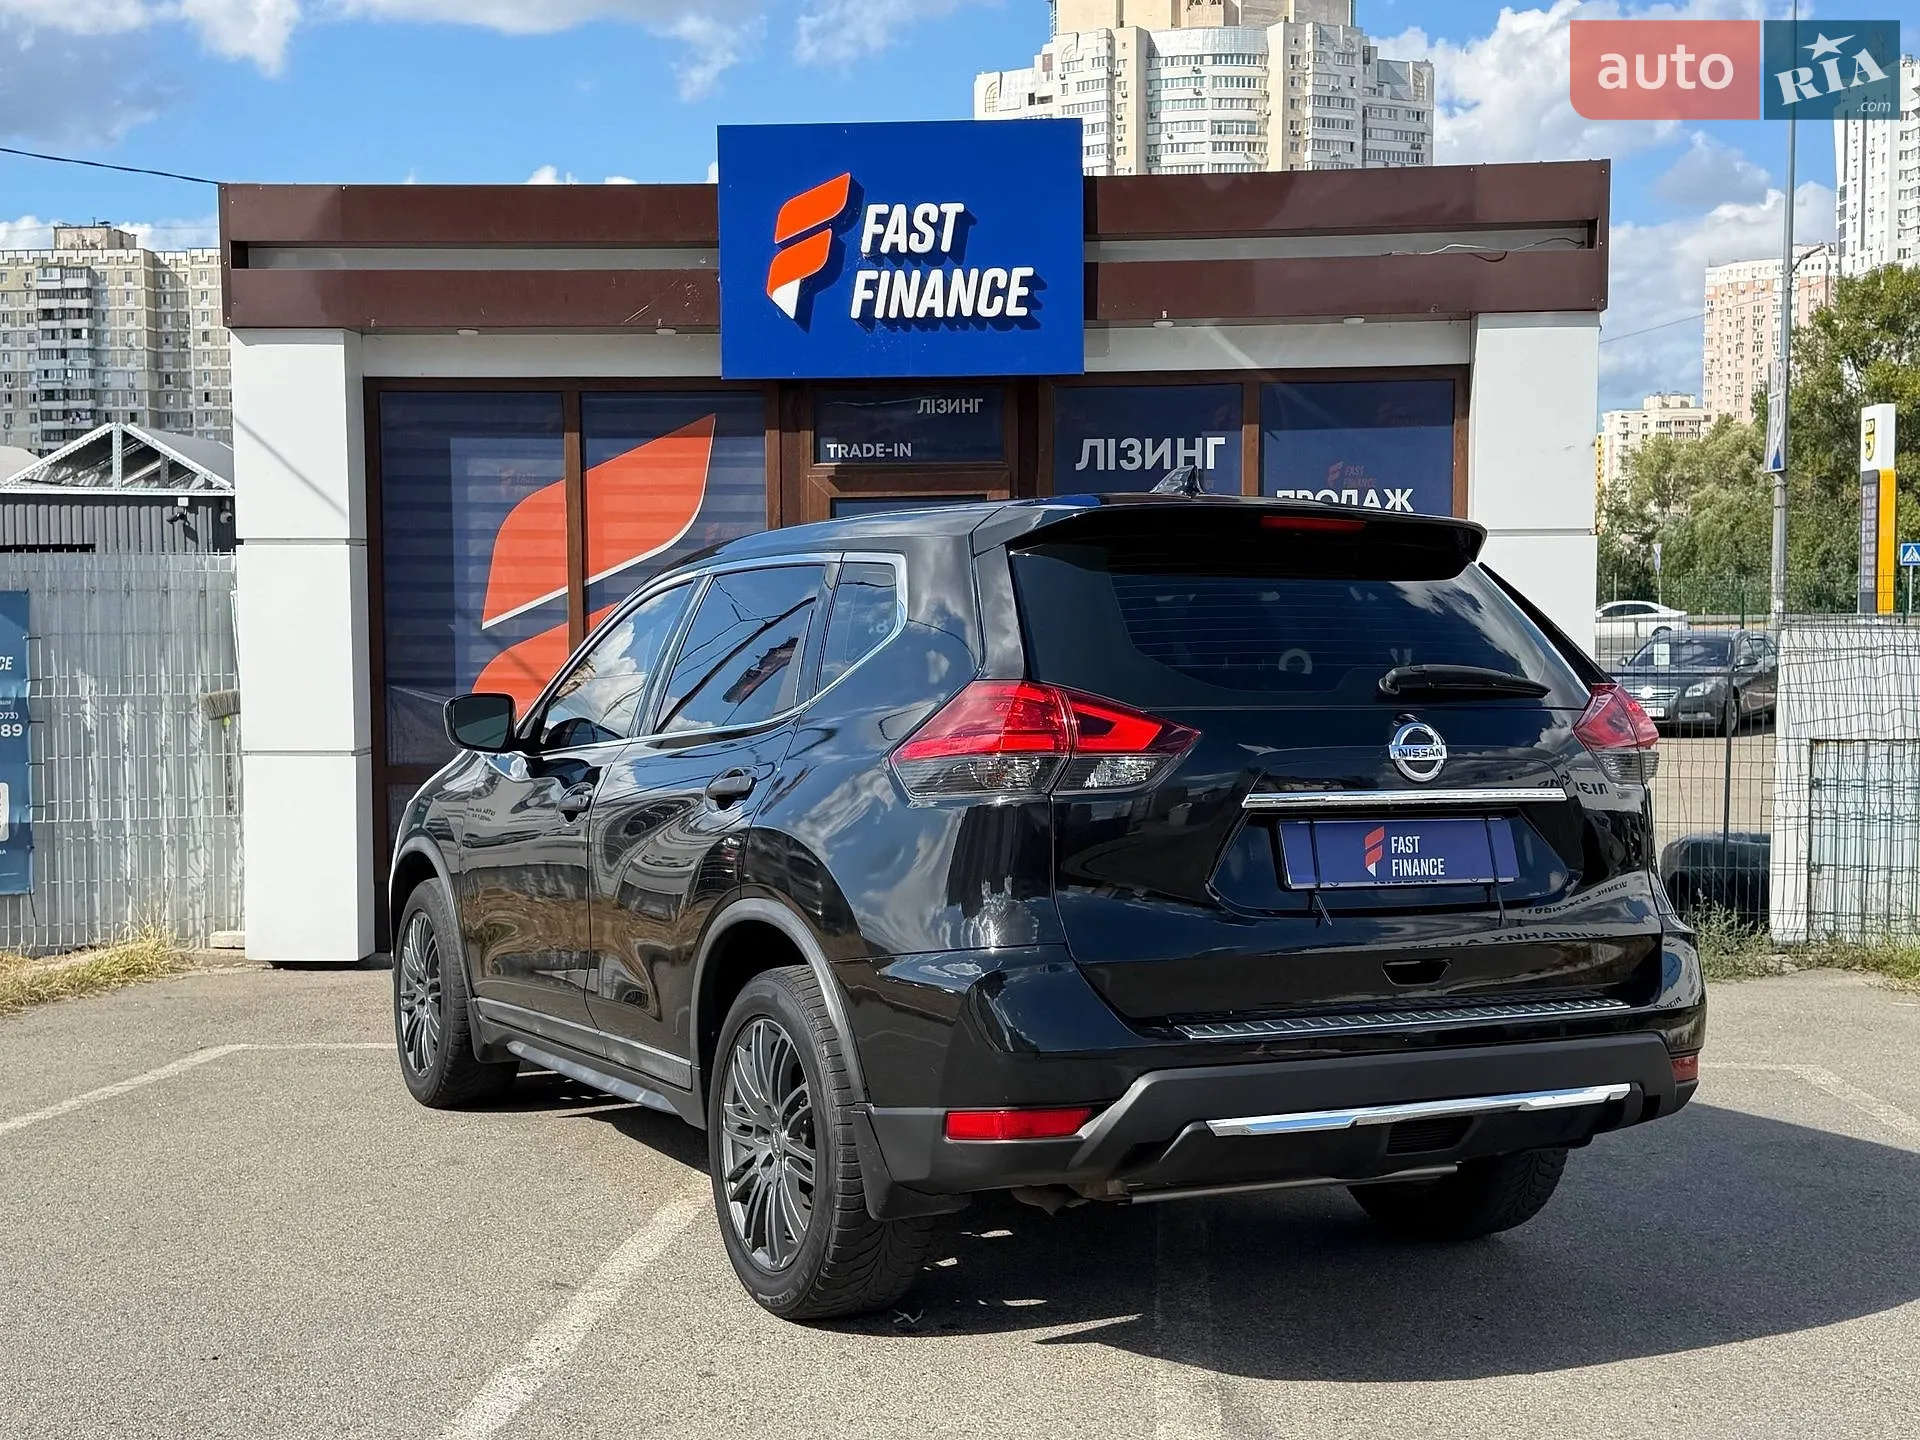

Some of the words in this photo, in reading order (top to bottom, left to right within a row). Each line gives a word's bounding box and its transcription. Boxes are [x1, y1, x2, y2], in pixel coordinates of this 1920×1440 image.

[860, 202, 965, 254] FAST
[850, 266, 1034, 319] FINANCE
[916, 398, 984, 415] ЛІЗИНГ
[826, 442, 913, 459] TRADE-IN
[1075, 436, 1226, 471] ЛІЗИНГ
[0, 723, 23, 737] 89
[1398, 748, 1443, 758] NISSAN
[1391, 835, 1421, 854] FAST
[1391, 857, 1446, 877] FINANCE
